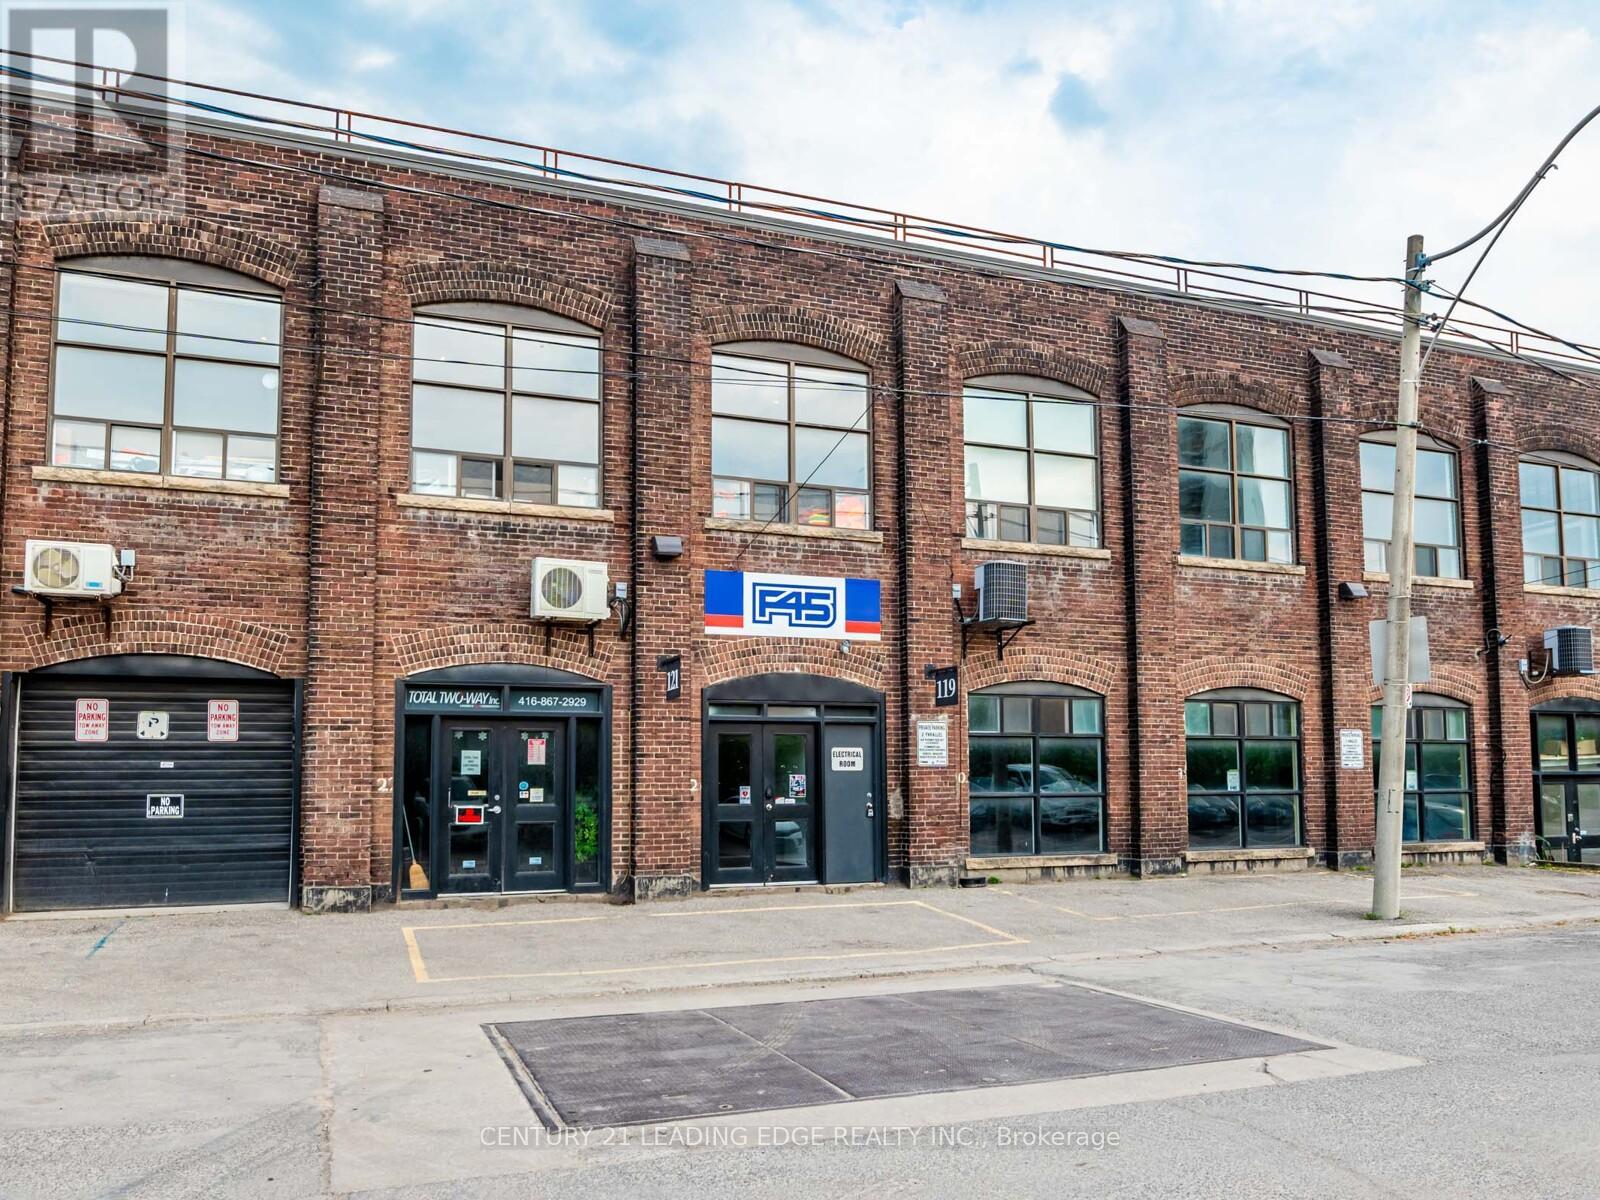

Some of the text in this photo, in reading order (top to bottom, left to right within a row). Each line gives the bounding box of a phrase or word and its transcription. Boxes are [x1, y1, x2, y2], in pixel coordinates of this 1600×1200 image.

[752, 582, 837, 628] F45
[667, 669, 679, 691] 121
[936, 678, 956, 699] 119
[408, 690, 438, 704] TOTAL
[439, 691, 490, 704] TWO-WAY
[518, 696, 587, 707] 416-867-2929
[86, 703, 99, 711] NO
[217, 703, 229, 712] NO
[78, 713, 106, 721] PARKING
[210, 714, 236, 722] PARKING
[832, 750, 862, 758] ELECTRICAL
[839, 760, 856, 768] ROOM
[160, 797, 171, 806] NO
[150, 806, 180, 816] PARKING
